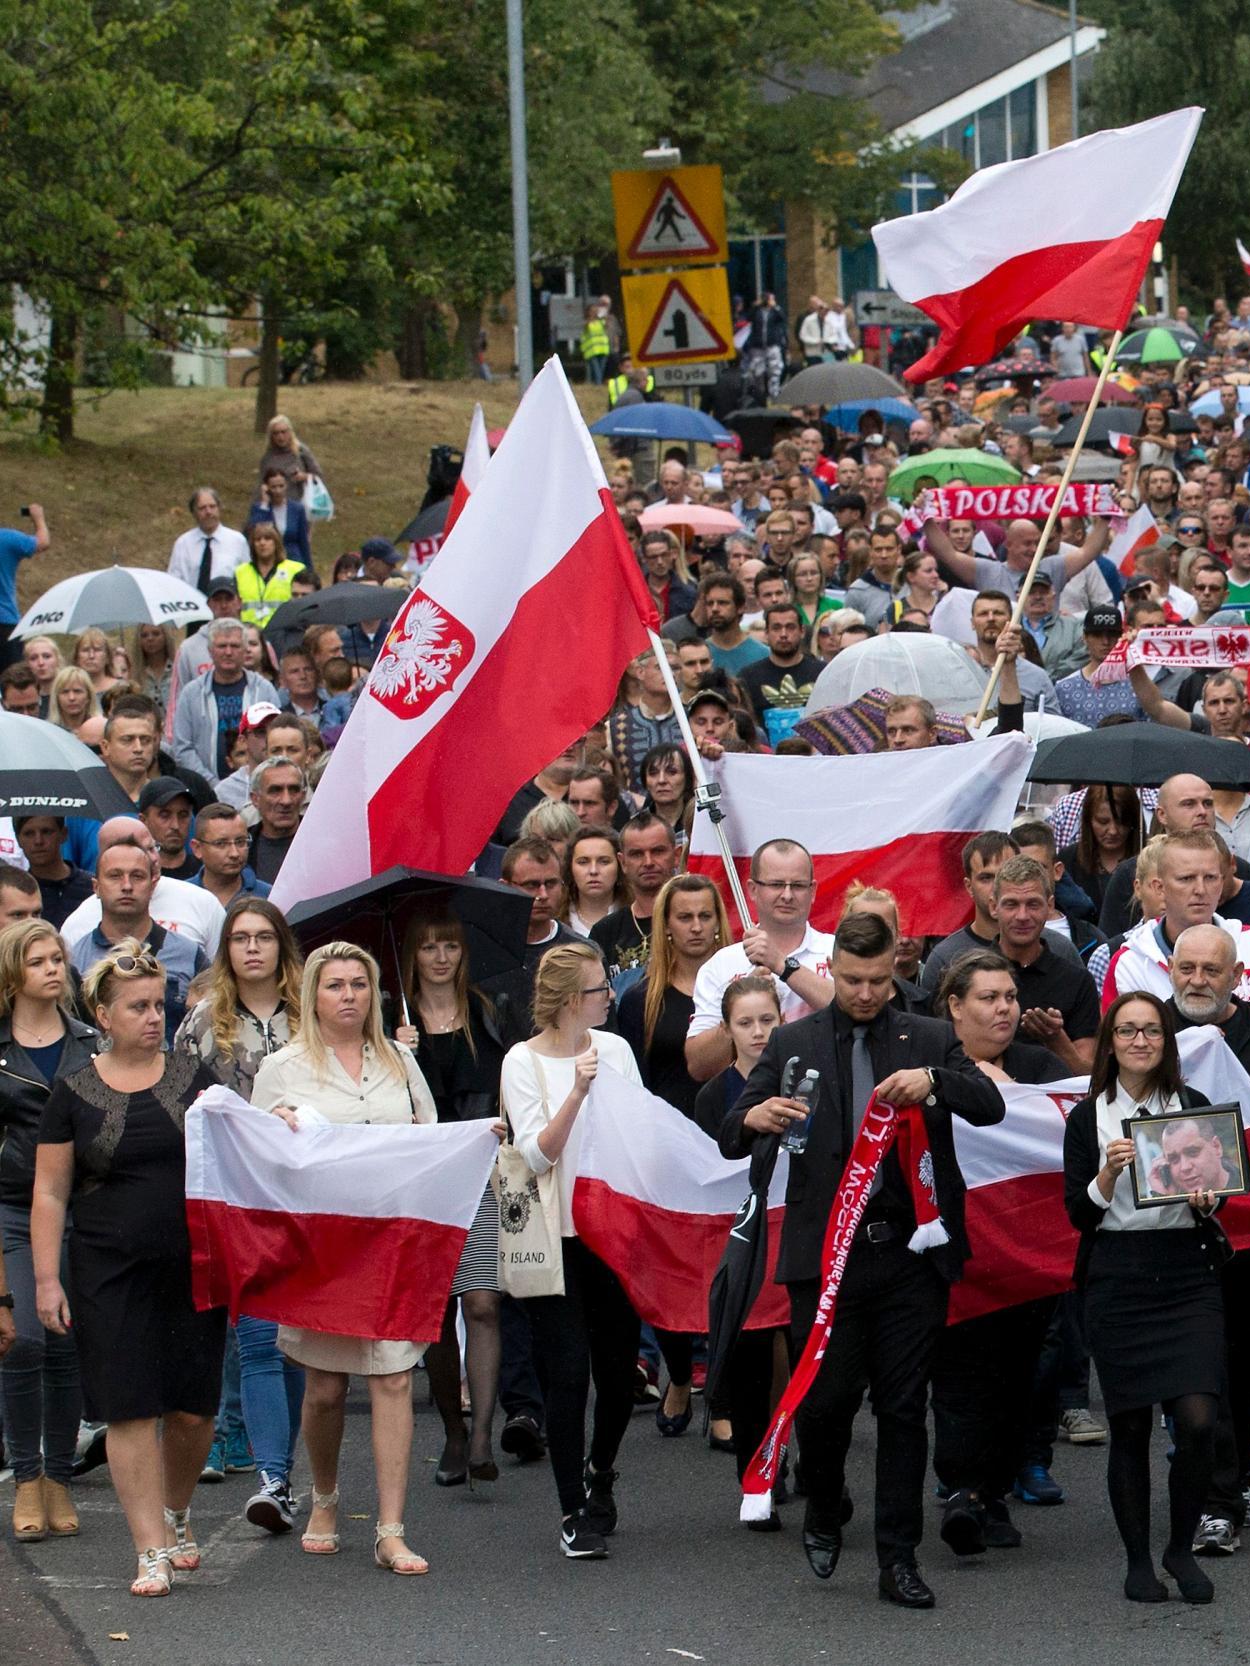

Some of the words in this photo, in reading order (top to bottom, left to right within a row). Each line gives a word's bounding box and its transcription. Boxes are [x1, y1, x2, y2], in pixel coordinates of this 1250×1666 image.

[954, 487, 1079, 517] POLSKA
[1093, 614, 1117, 626] 1995
[9, 796, 88, 808] DUNLOP
[510, 1252, 546, 1264] ISLAND
